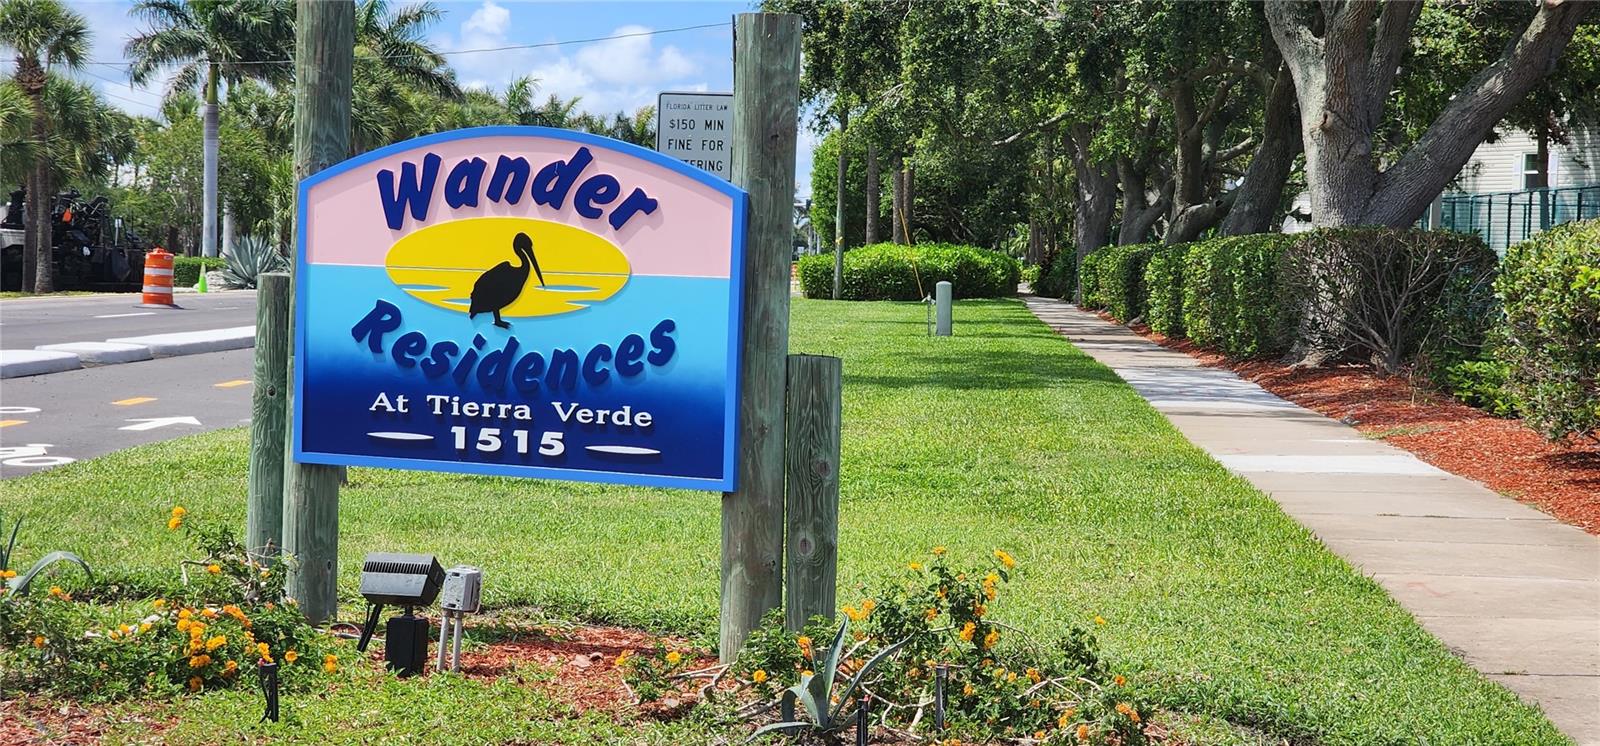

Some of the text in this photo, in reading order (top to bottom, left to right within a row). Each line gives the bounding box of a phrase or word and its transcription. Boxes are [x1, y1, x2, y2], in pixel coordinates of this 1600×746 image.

[669, 119, 724, 131] $150 MIN
[667, 139, 724, 151] FINE FOR
[376, 147, 659, 231] Wander
[351, 299, 677, 391] Residences
[369, 392, 653, 427] At Tierra Verde
[450, 426, 566, 456] 1515
